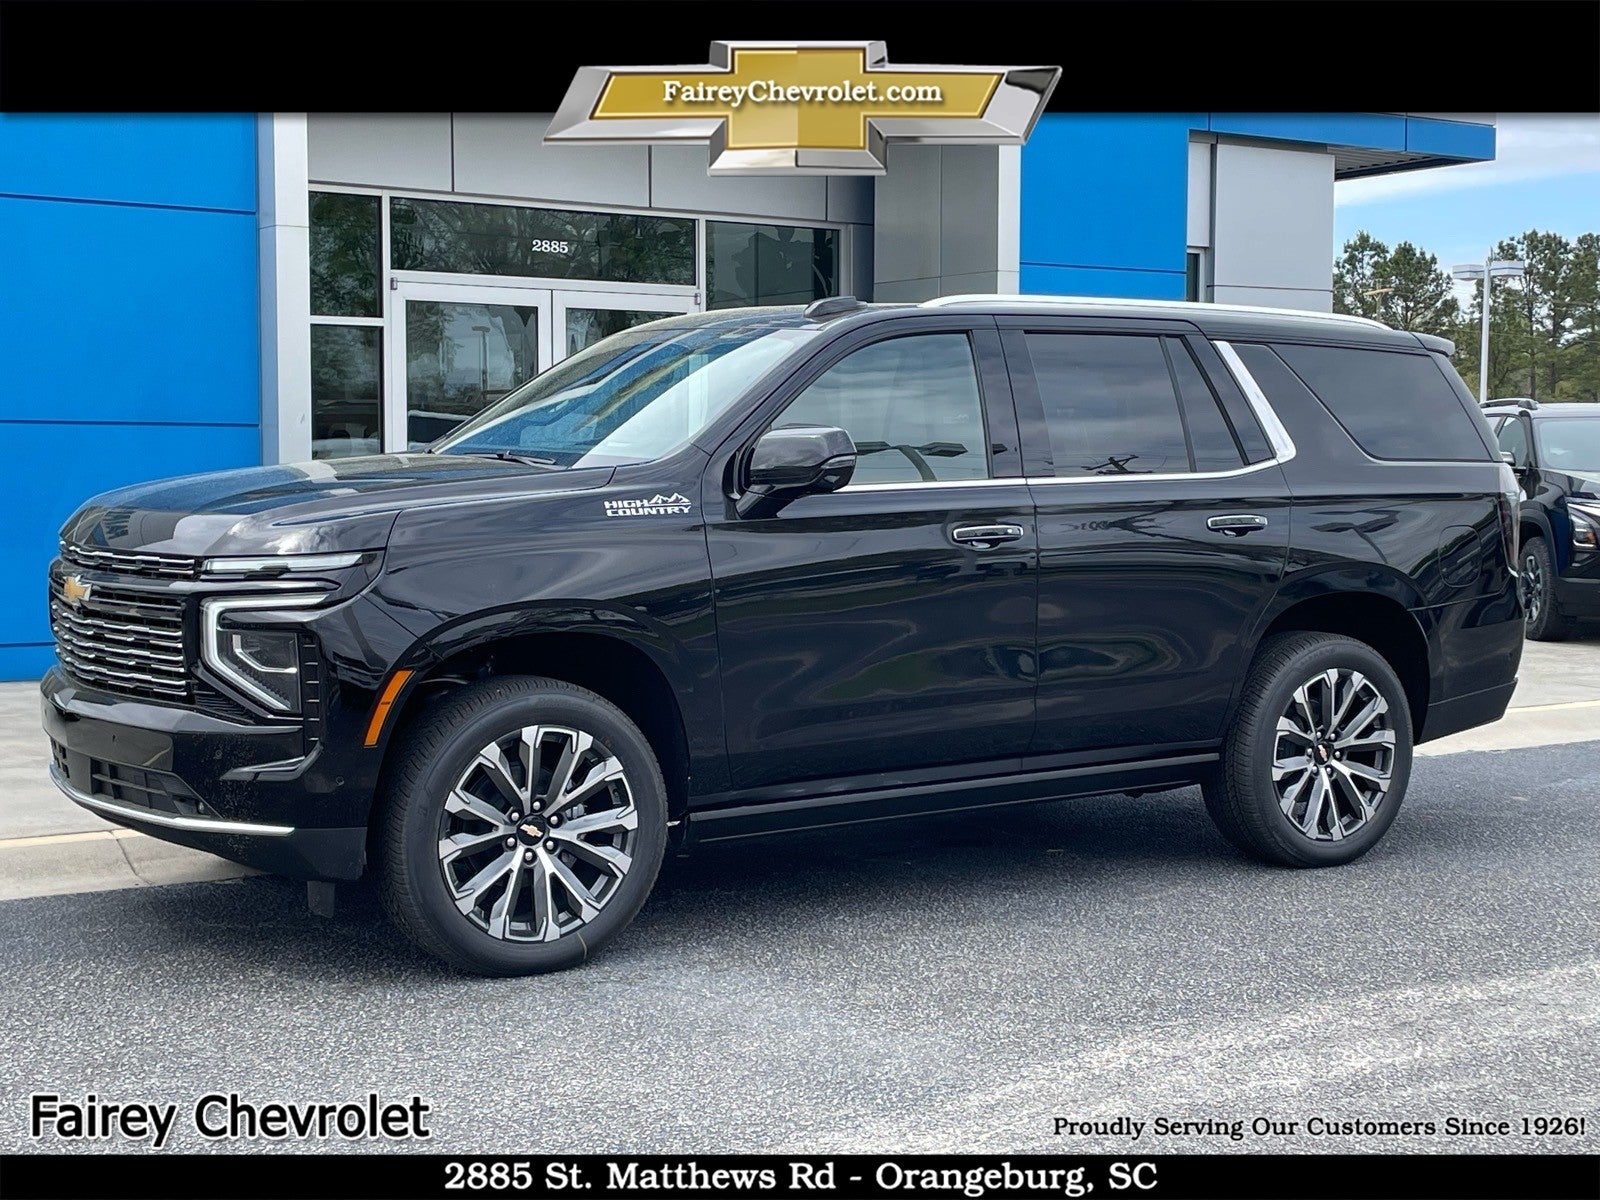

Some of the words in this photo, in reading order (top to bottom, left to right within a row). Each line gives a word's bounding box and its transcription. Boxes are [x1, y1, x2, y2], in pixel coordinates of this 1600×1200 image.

[531, 239, 569, 254] 2885
[603, 499, 649, 508] HIGH
[606, 505, 691, 517] COUNTRY
